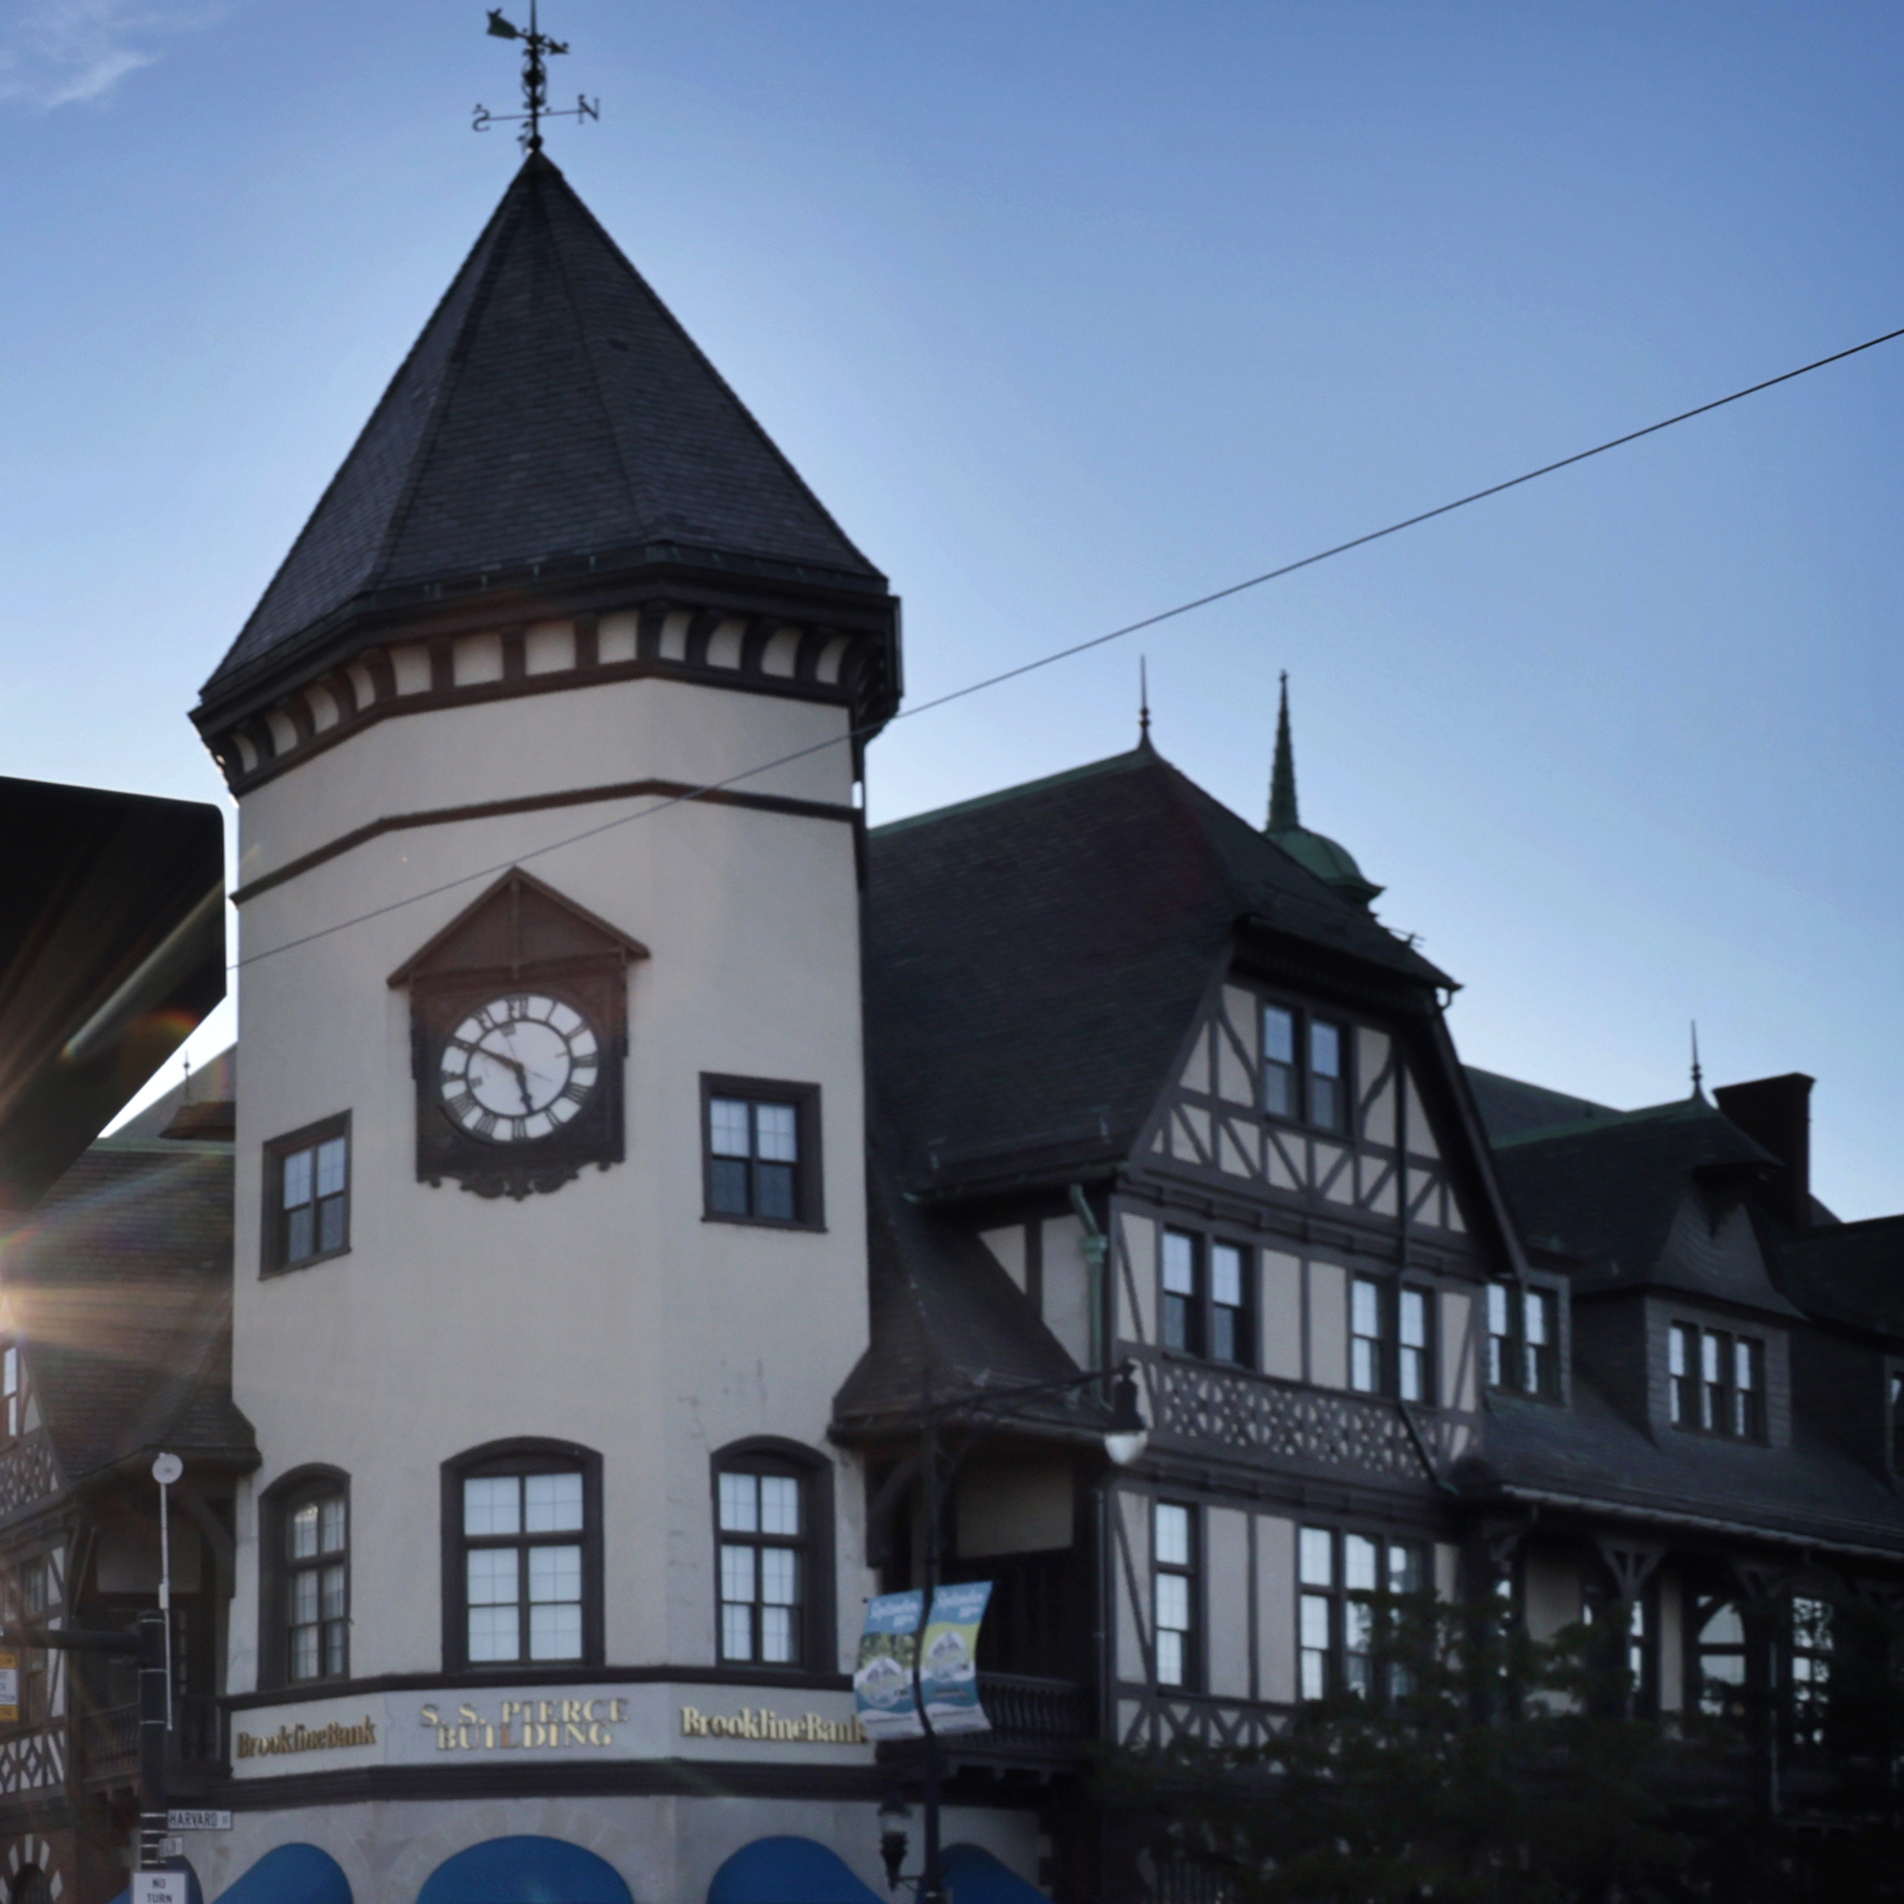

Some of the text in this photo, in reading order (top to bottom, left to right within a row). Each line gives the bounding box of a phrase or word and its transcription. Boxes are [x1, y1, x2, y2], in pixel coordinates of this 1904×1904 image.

[420, 1697, 631, 1728] S. S. PIERCE
[681, 1705, 869, 1744] BrooklineBank
[237, 1714, 376, 1758] BrooklineBank
[436, 1723, 614, 1750] BUILDING
[168, 1811, 218, 1827] HARVARD
[152, 1878, 166, 1889] NO
[147, 1894, 172, 1904] TURN
